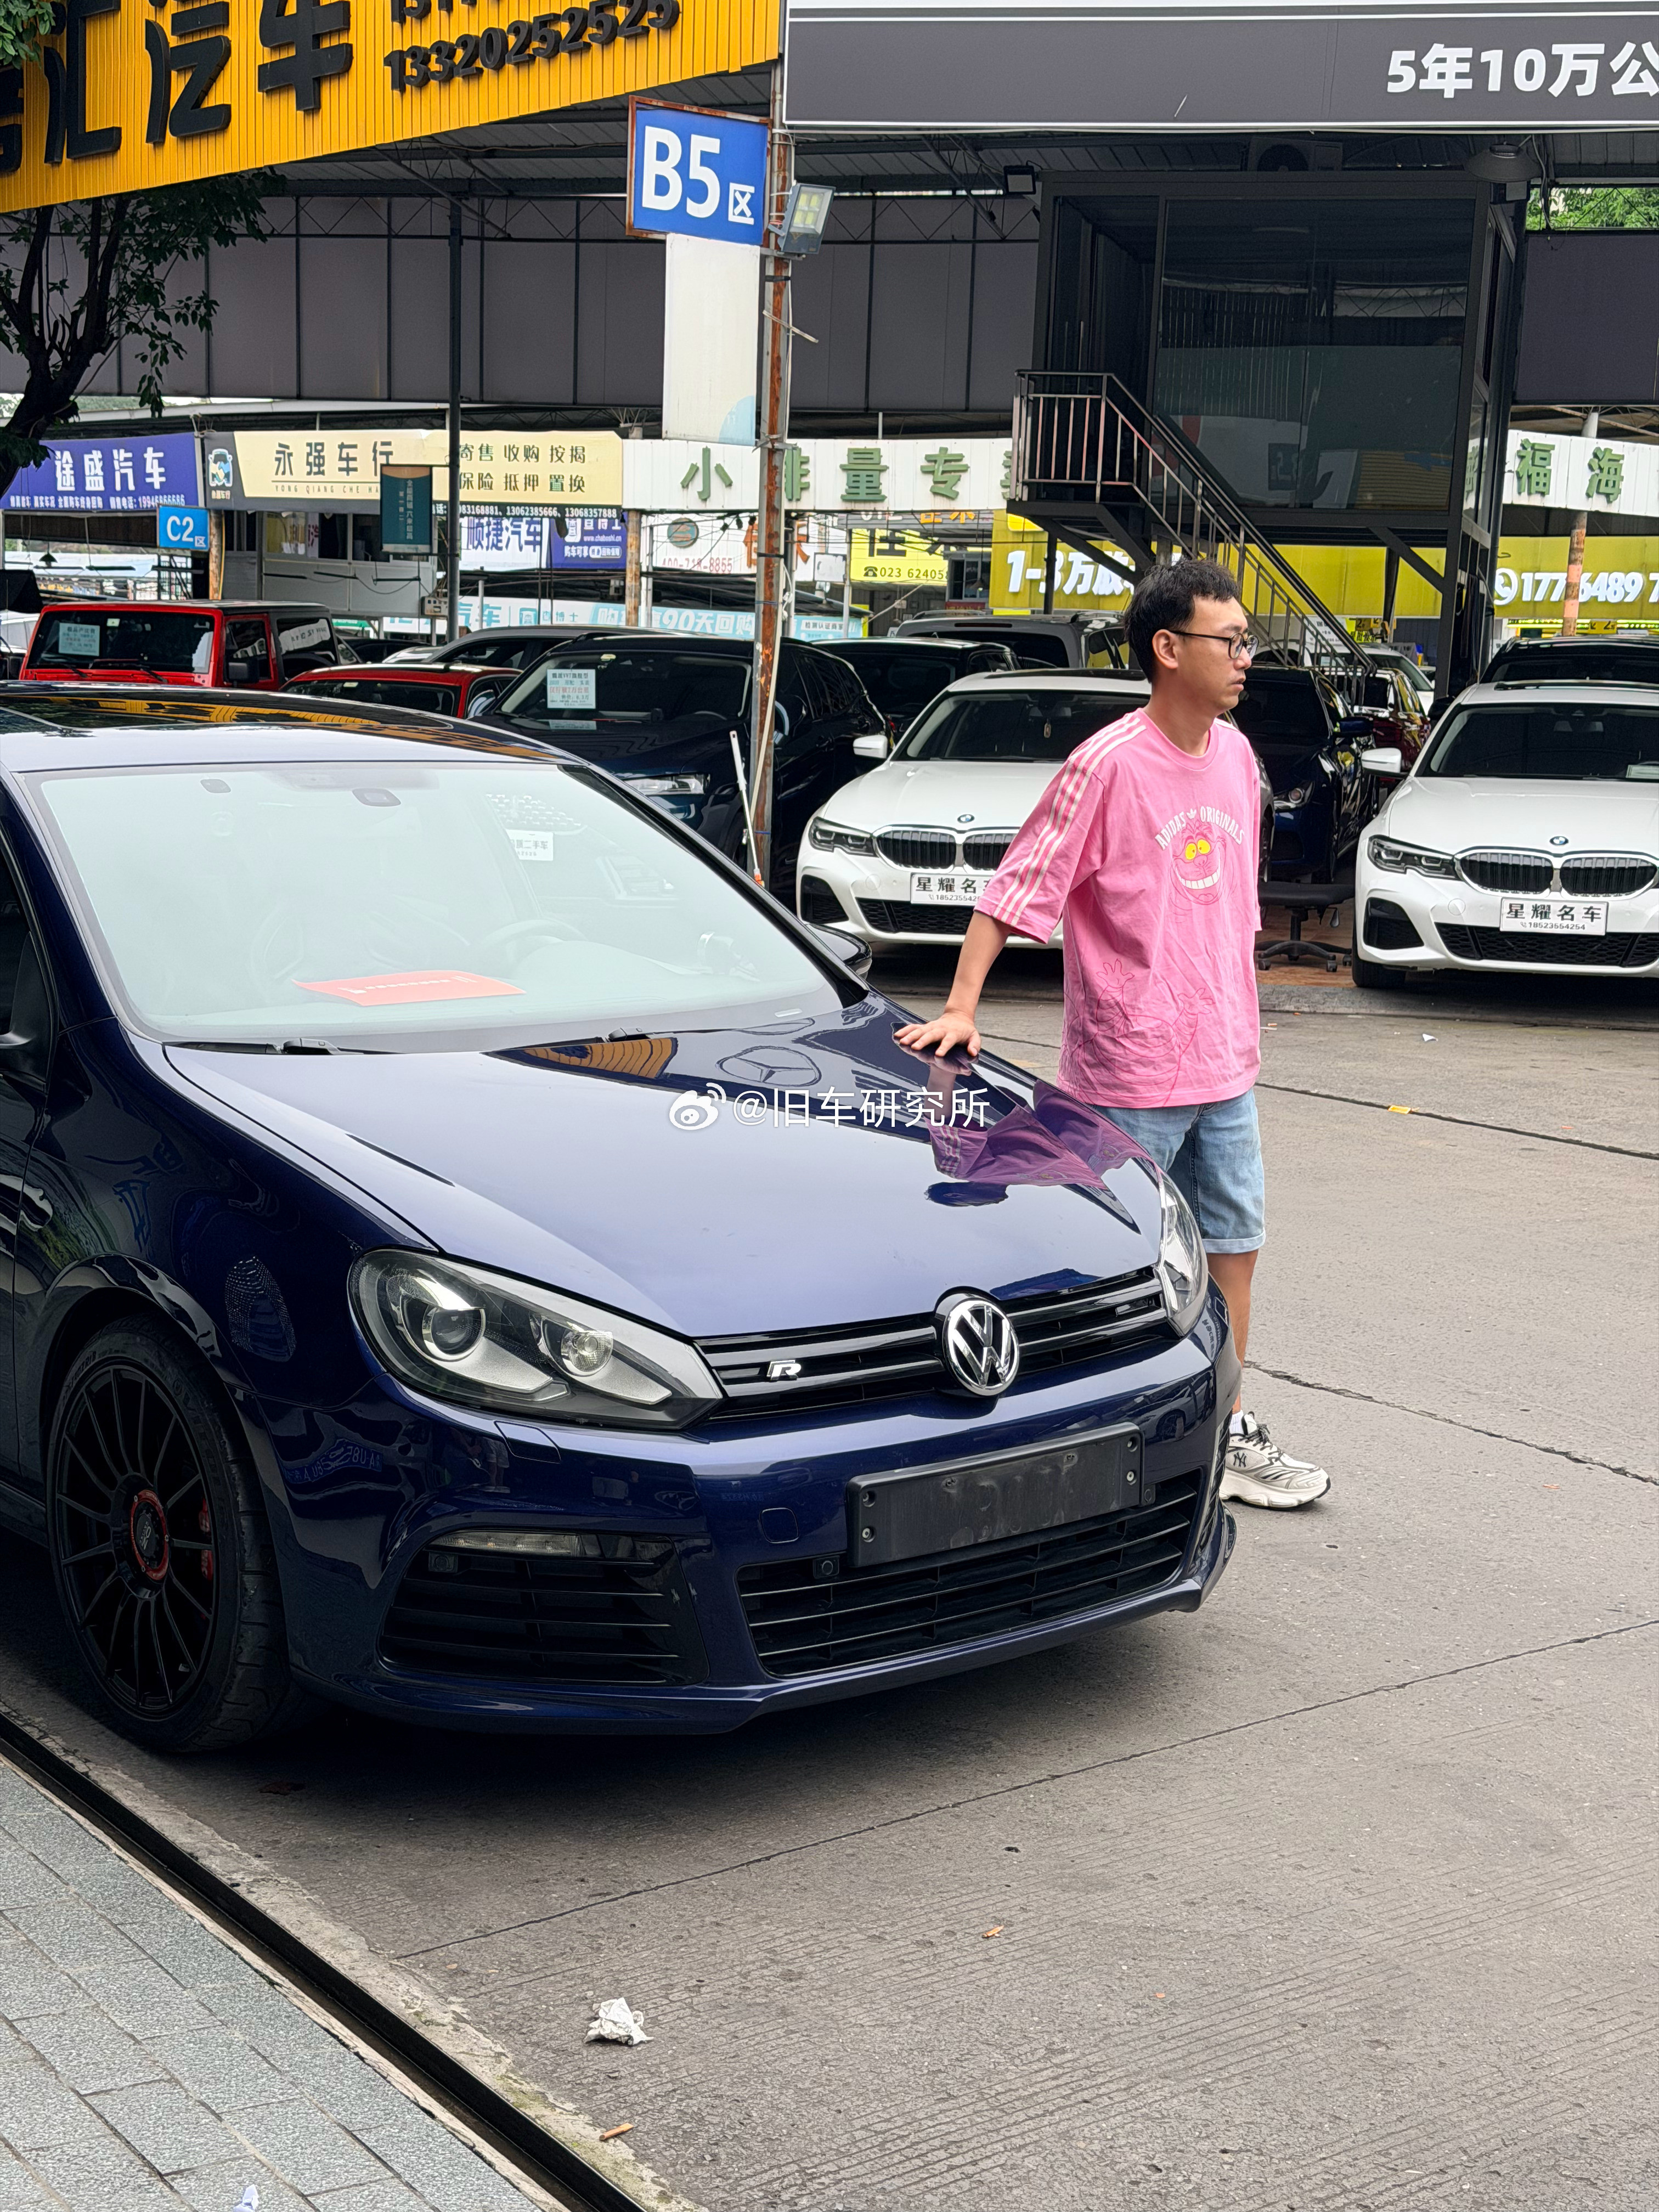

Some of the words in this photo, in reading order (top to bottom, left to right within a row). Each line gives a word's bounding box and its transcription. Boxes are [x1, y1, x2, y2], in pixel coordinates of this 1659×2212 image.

[383, 0, 680, 92] 13320252525
[0, 0, 353, 173] 汇汽车
[1386, 41, 1659, 99] 5年10万公
[641, 125, 755, 225] B5区
[274, 441, 394, 477] 永强车行
[459, 443, 494, 462] 寄售
[504, 444, 539, 463] 收购
[549, 445, 585, 464] 按揭
[459, 472, 494, 490] 保险
[504, 472, 539, 492] 抵押
[549, 474, 585, 493] 置换
[1516, 438, 1625, 504] 福海
[166, 515, 207, 548] C2区
[879, 567, 901, 578] 023
[1154, 811, 1187, 851] ADIDAS
[1200, 806, 1245, 845] ORIGINALS
[1505, 902, 1602, 923] 星耀名车
[766, 1359, 802, 1381] R
[1233, 1451, 1247, 1468] NY
